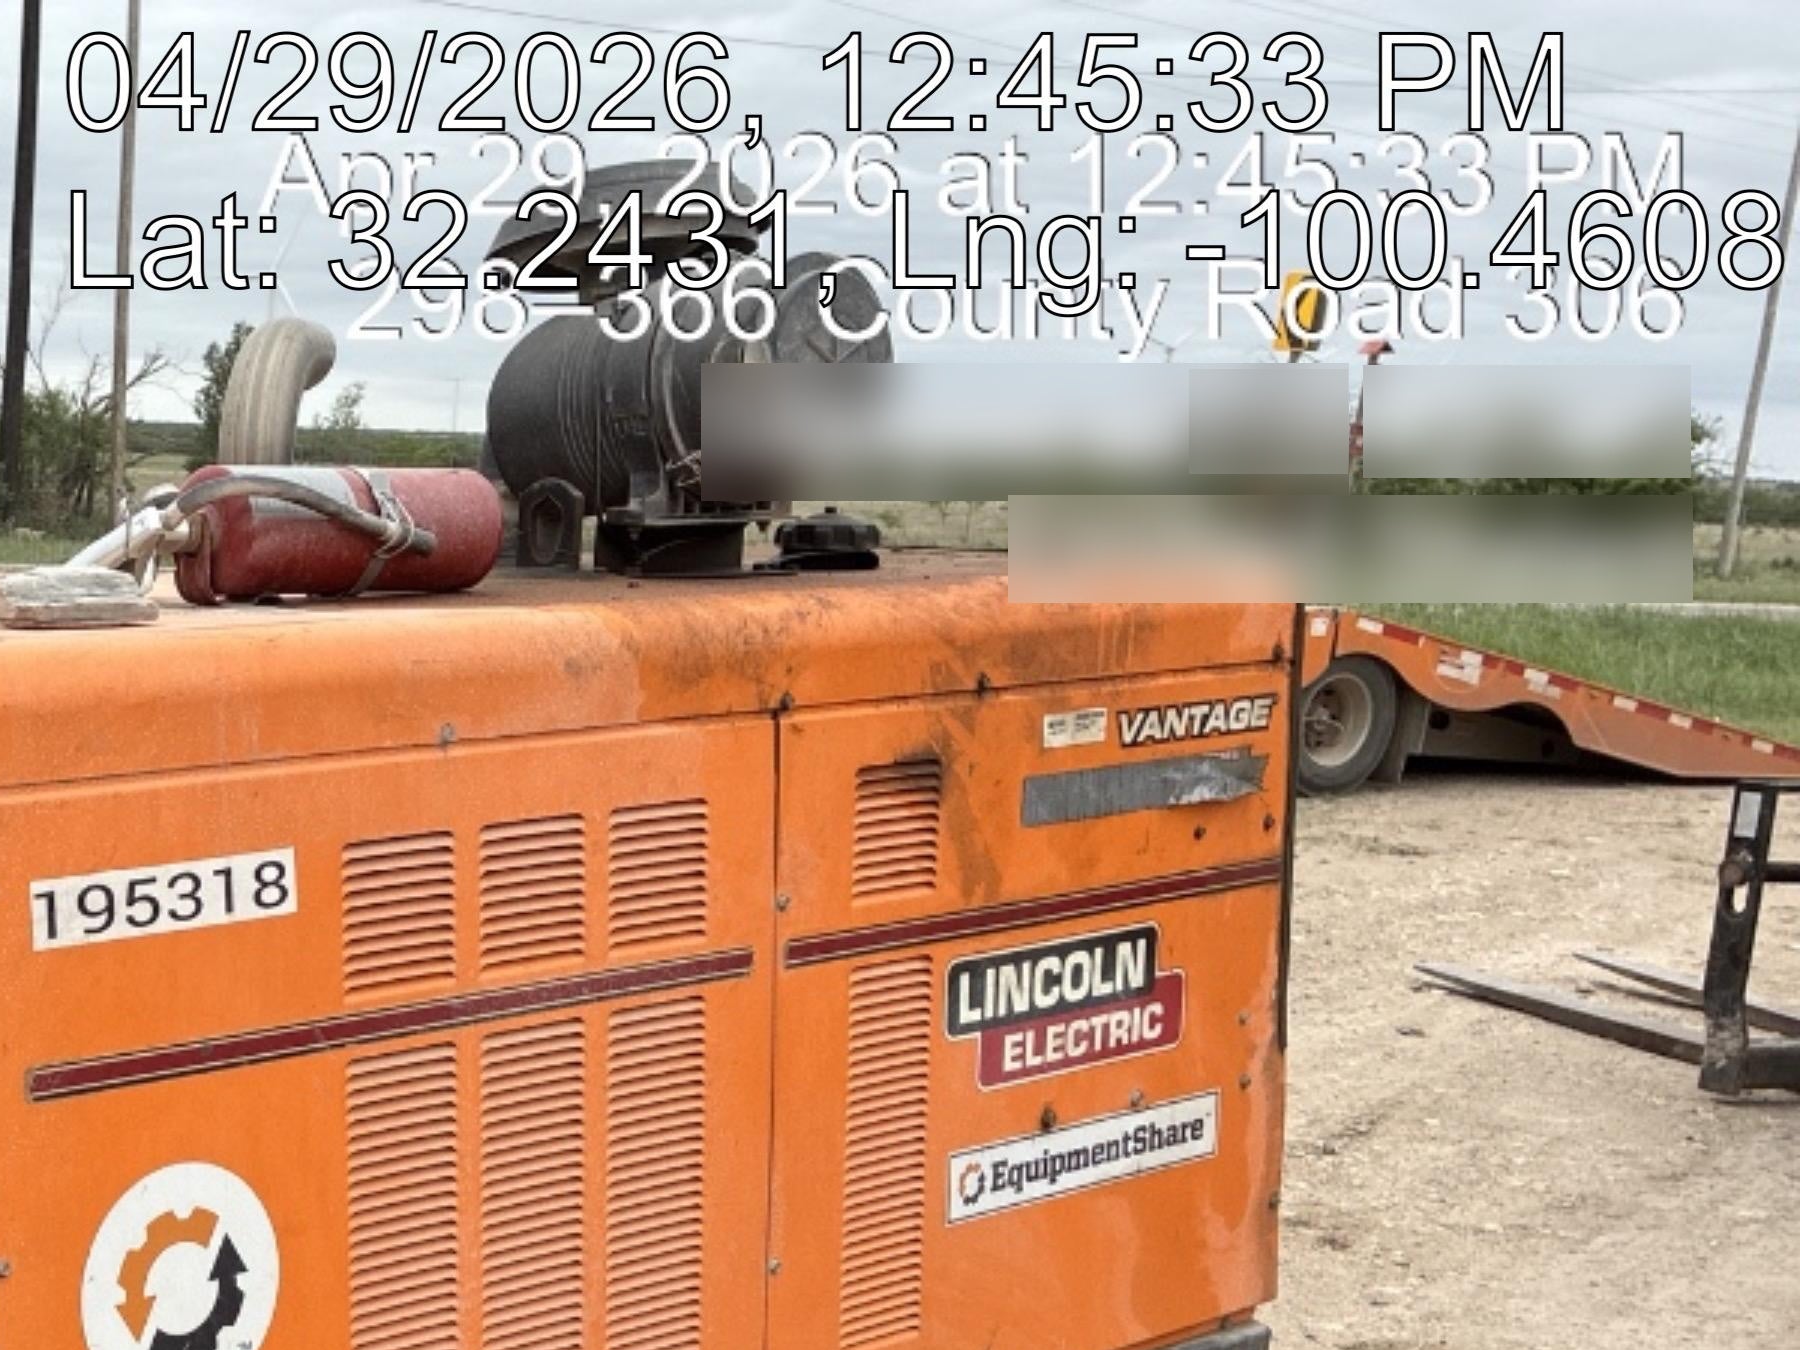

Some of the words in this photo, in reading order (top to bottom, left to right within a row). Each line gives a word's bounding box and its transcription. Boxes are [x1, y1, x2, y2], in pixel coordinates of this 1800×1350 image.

[1118, 694, 1277, 746] VANTAGE
[33, 860, 289, 940] 195318
[958, 938, 1148, 1025] LINCOLN
[1002, 1002, 1165, 1073] ELECTRIC
[990, 1116, 1205, 1194] EquipmentShare
